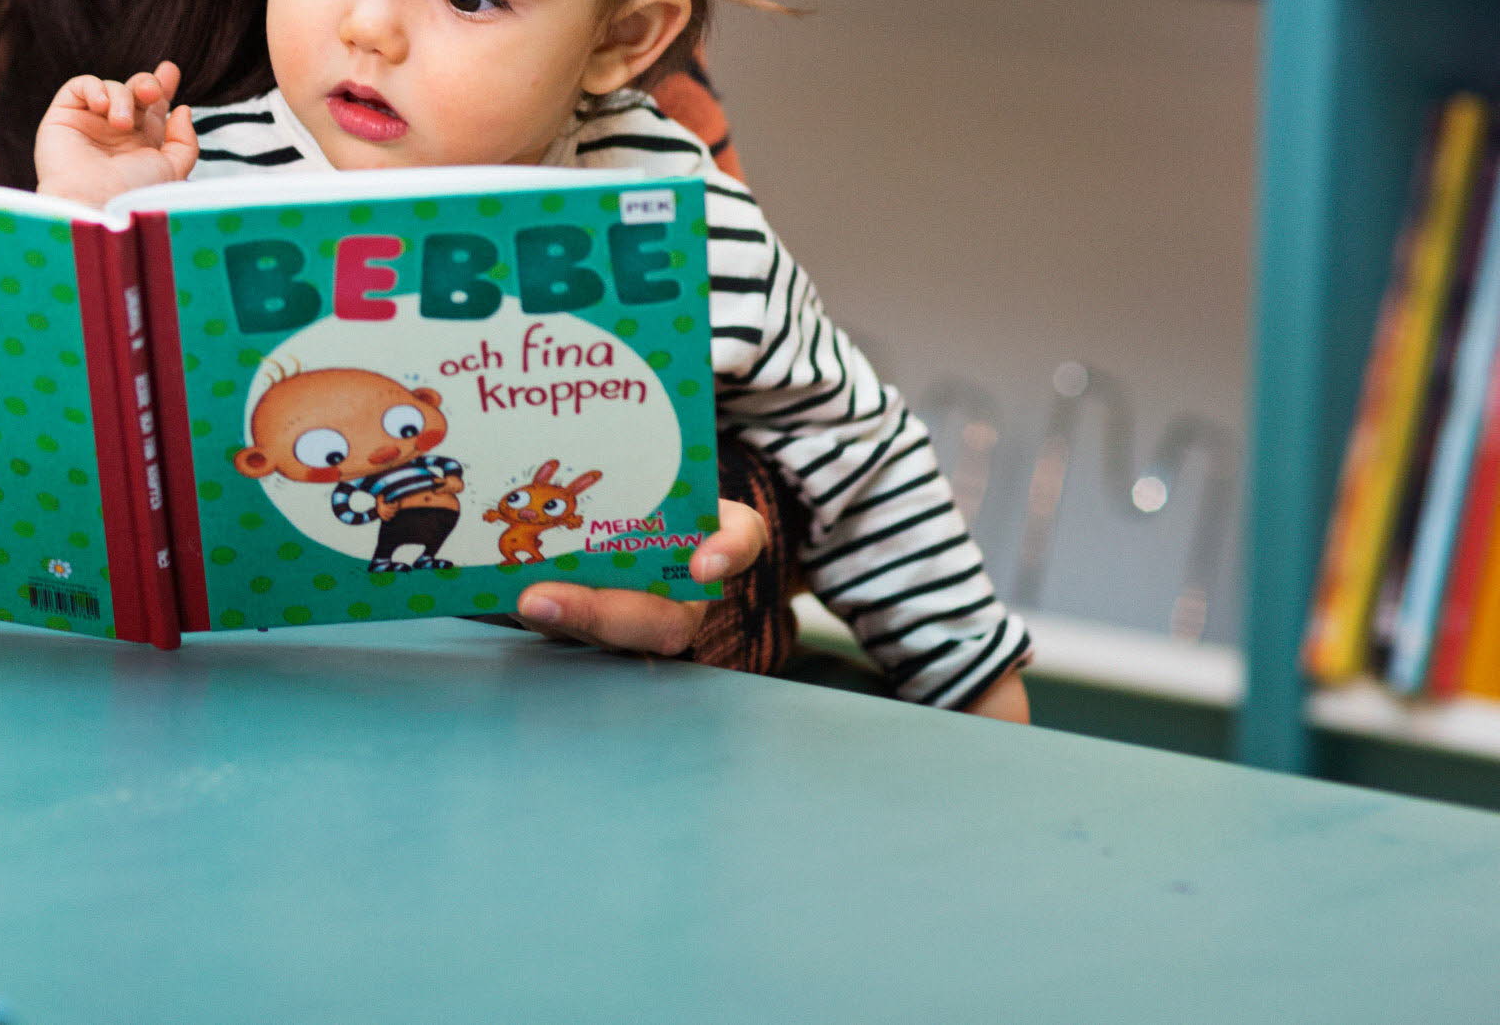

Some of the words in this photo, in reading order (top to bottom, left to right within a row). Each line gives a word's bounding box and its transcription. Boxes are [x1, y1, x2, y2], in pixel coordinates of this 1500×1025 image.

[625, 200, 671, 215] PEK
[223, 222, 682, 335] BEBBE
[438, 338, 504, 377] och
[521, 321, 616, 373] fina
[475, 374, 649, 417] kroppen
